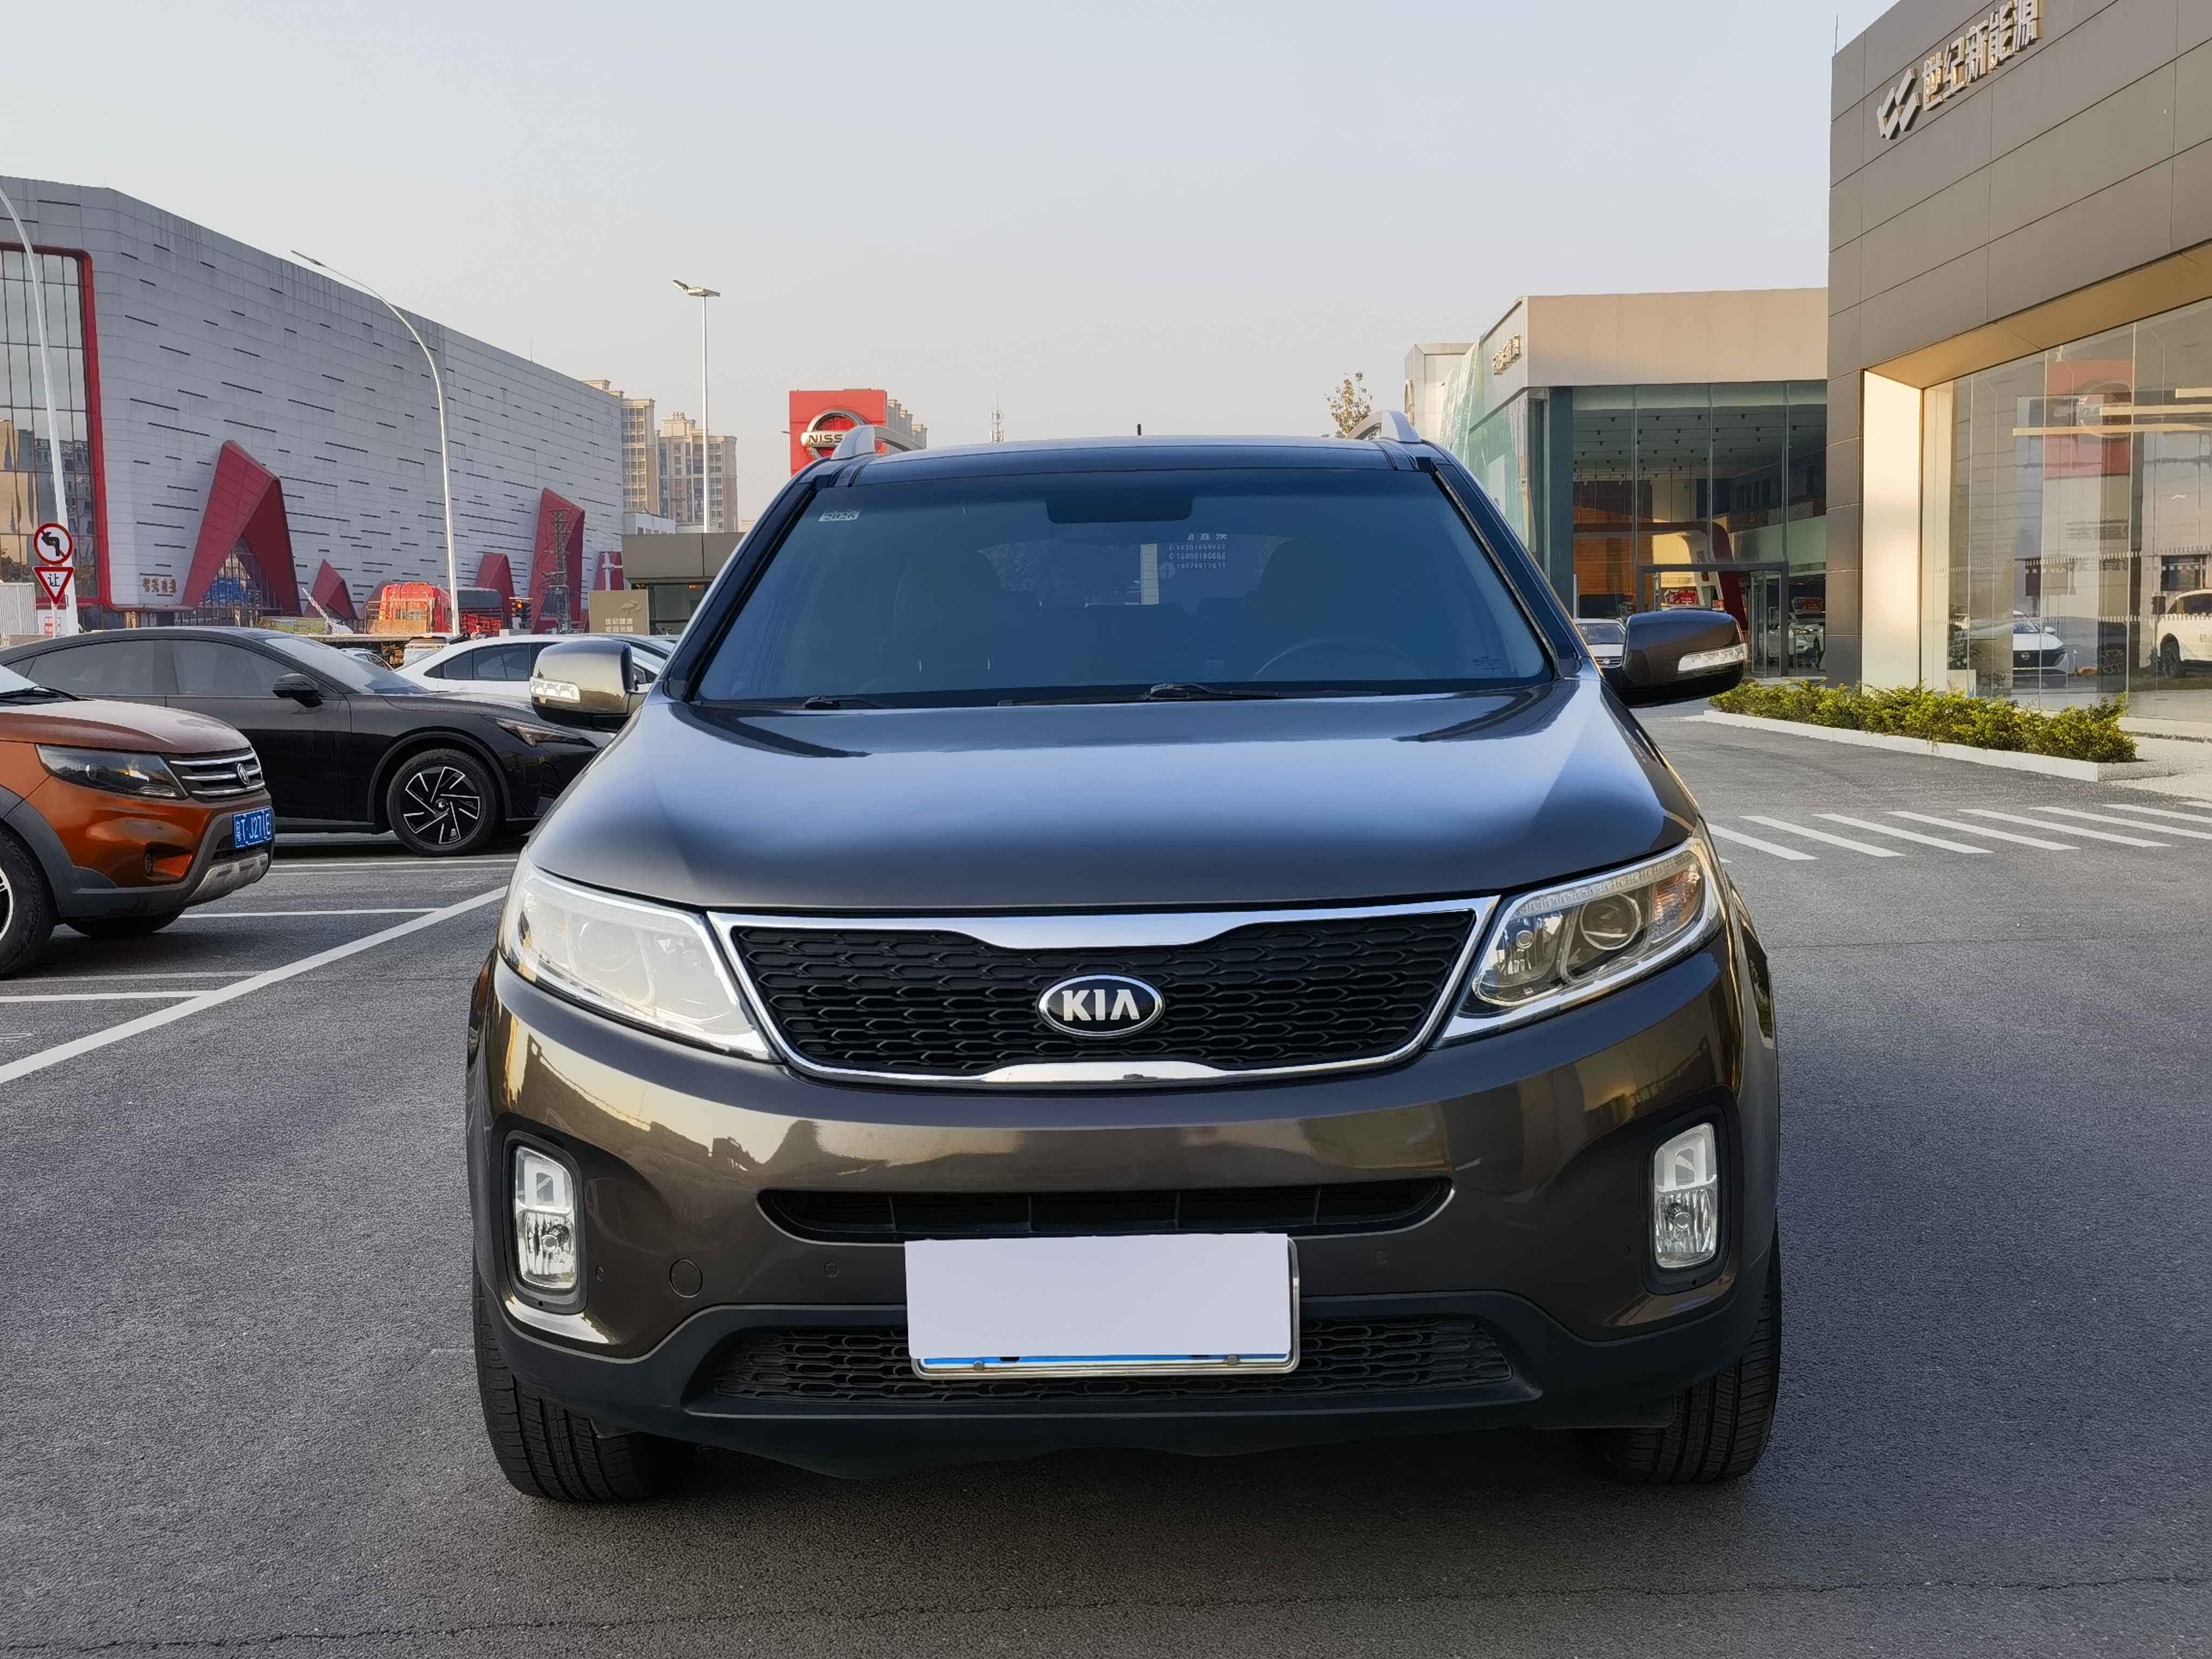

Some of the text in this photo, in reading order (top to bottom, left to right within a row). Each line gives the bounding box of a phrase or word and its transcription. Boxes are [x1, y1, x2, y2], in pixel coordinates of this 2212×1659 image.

[1922, 0, 2039, 111] 世纪新能源
[808, 434, 843, 444] NISS
[47, 572, 61, 587] 让
[1062, 989, 1140, 1021] KIA
